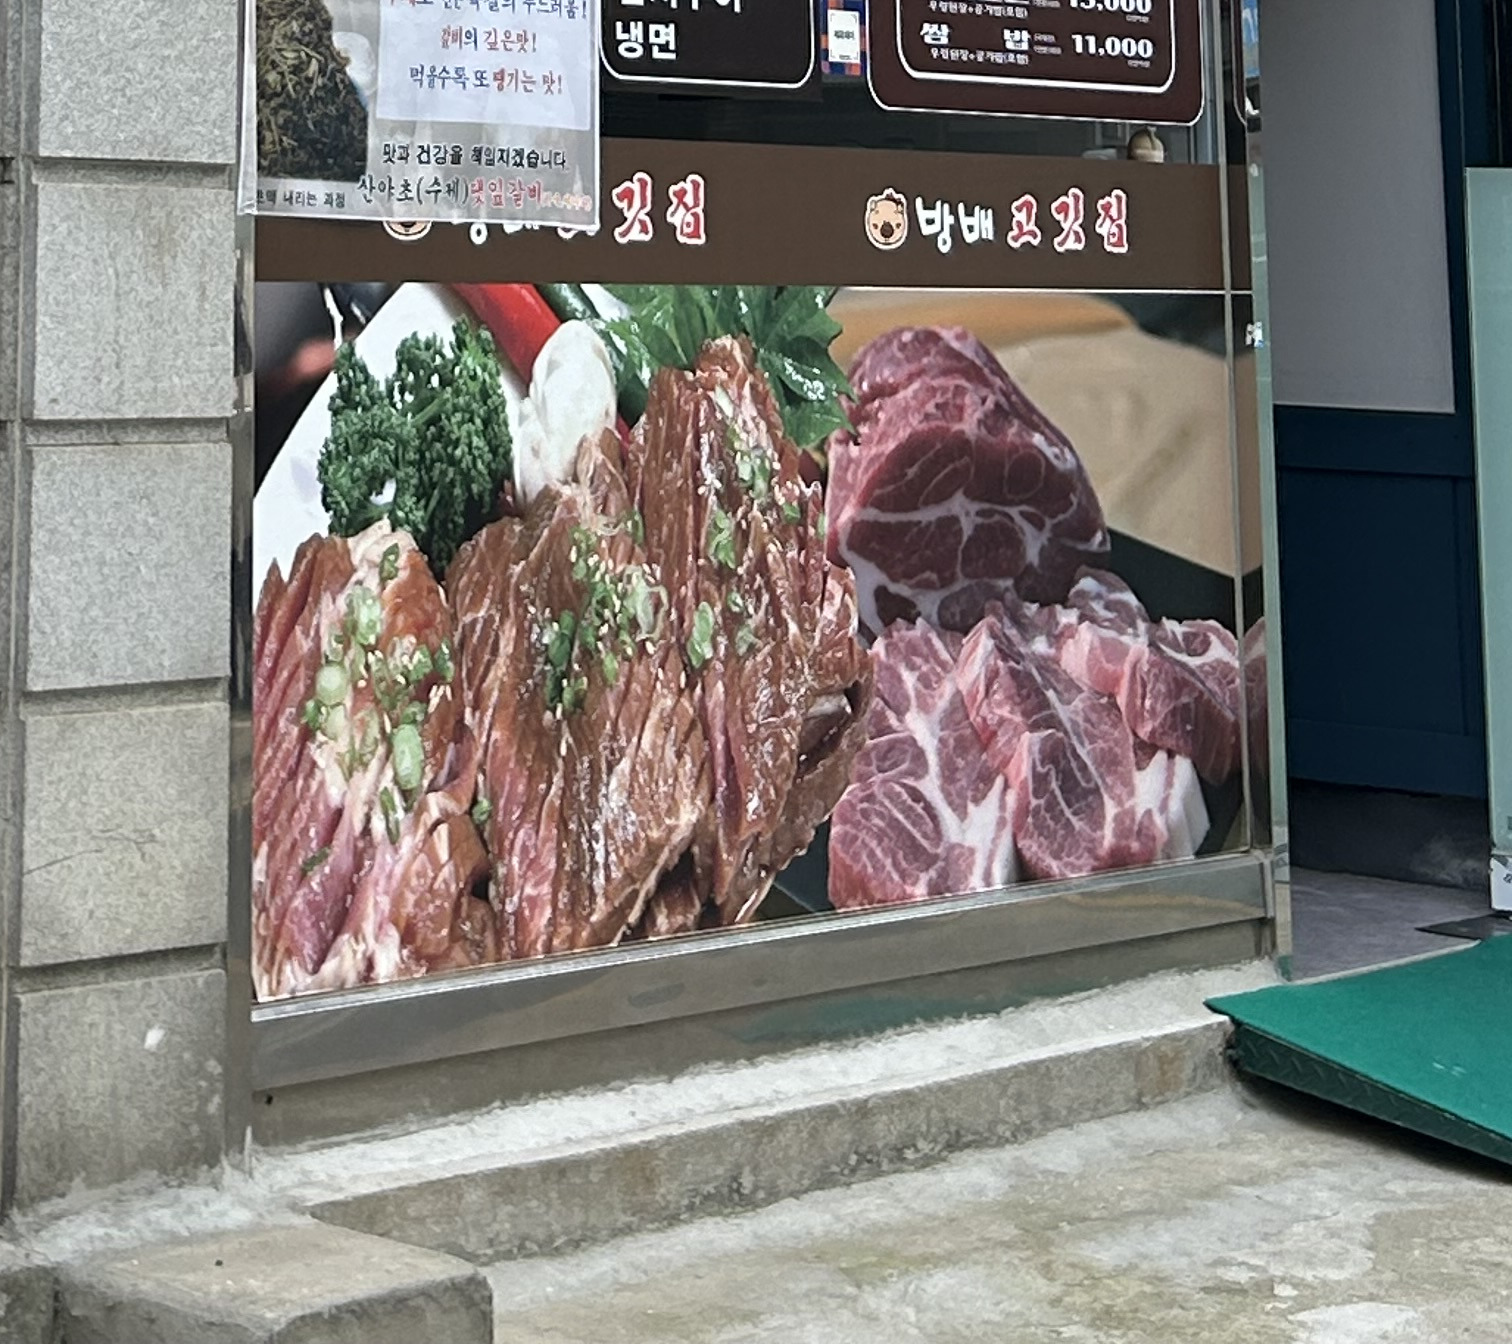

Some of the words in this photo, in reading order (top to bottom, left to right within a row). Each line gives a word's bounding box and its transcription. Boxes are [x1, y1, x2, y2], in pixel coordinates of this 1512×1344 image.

[615, 21, 678, 60] 냉면
[1071, 34, 1154, 59] 11,000
[473, 69, 490, 88] 또
[382, 143, 410, 165] 맛과
[415, 143, 463, 165] 건강을
[282, 188, 317, 208] 내리는
[916, 195, 995, 256] 방배
[1005, 186, 1130, 254] 고깃집
